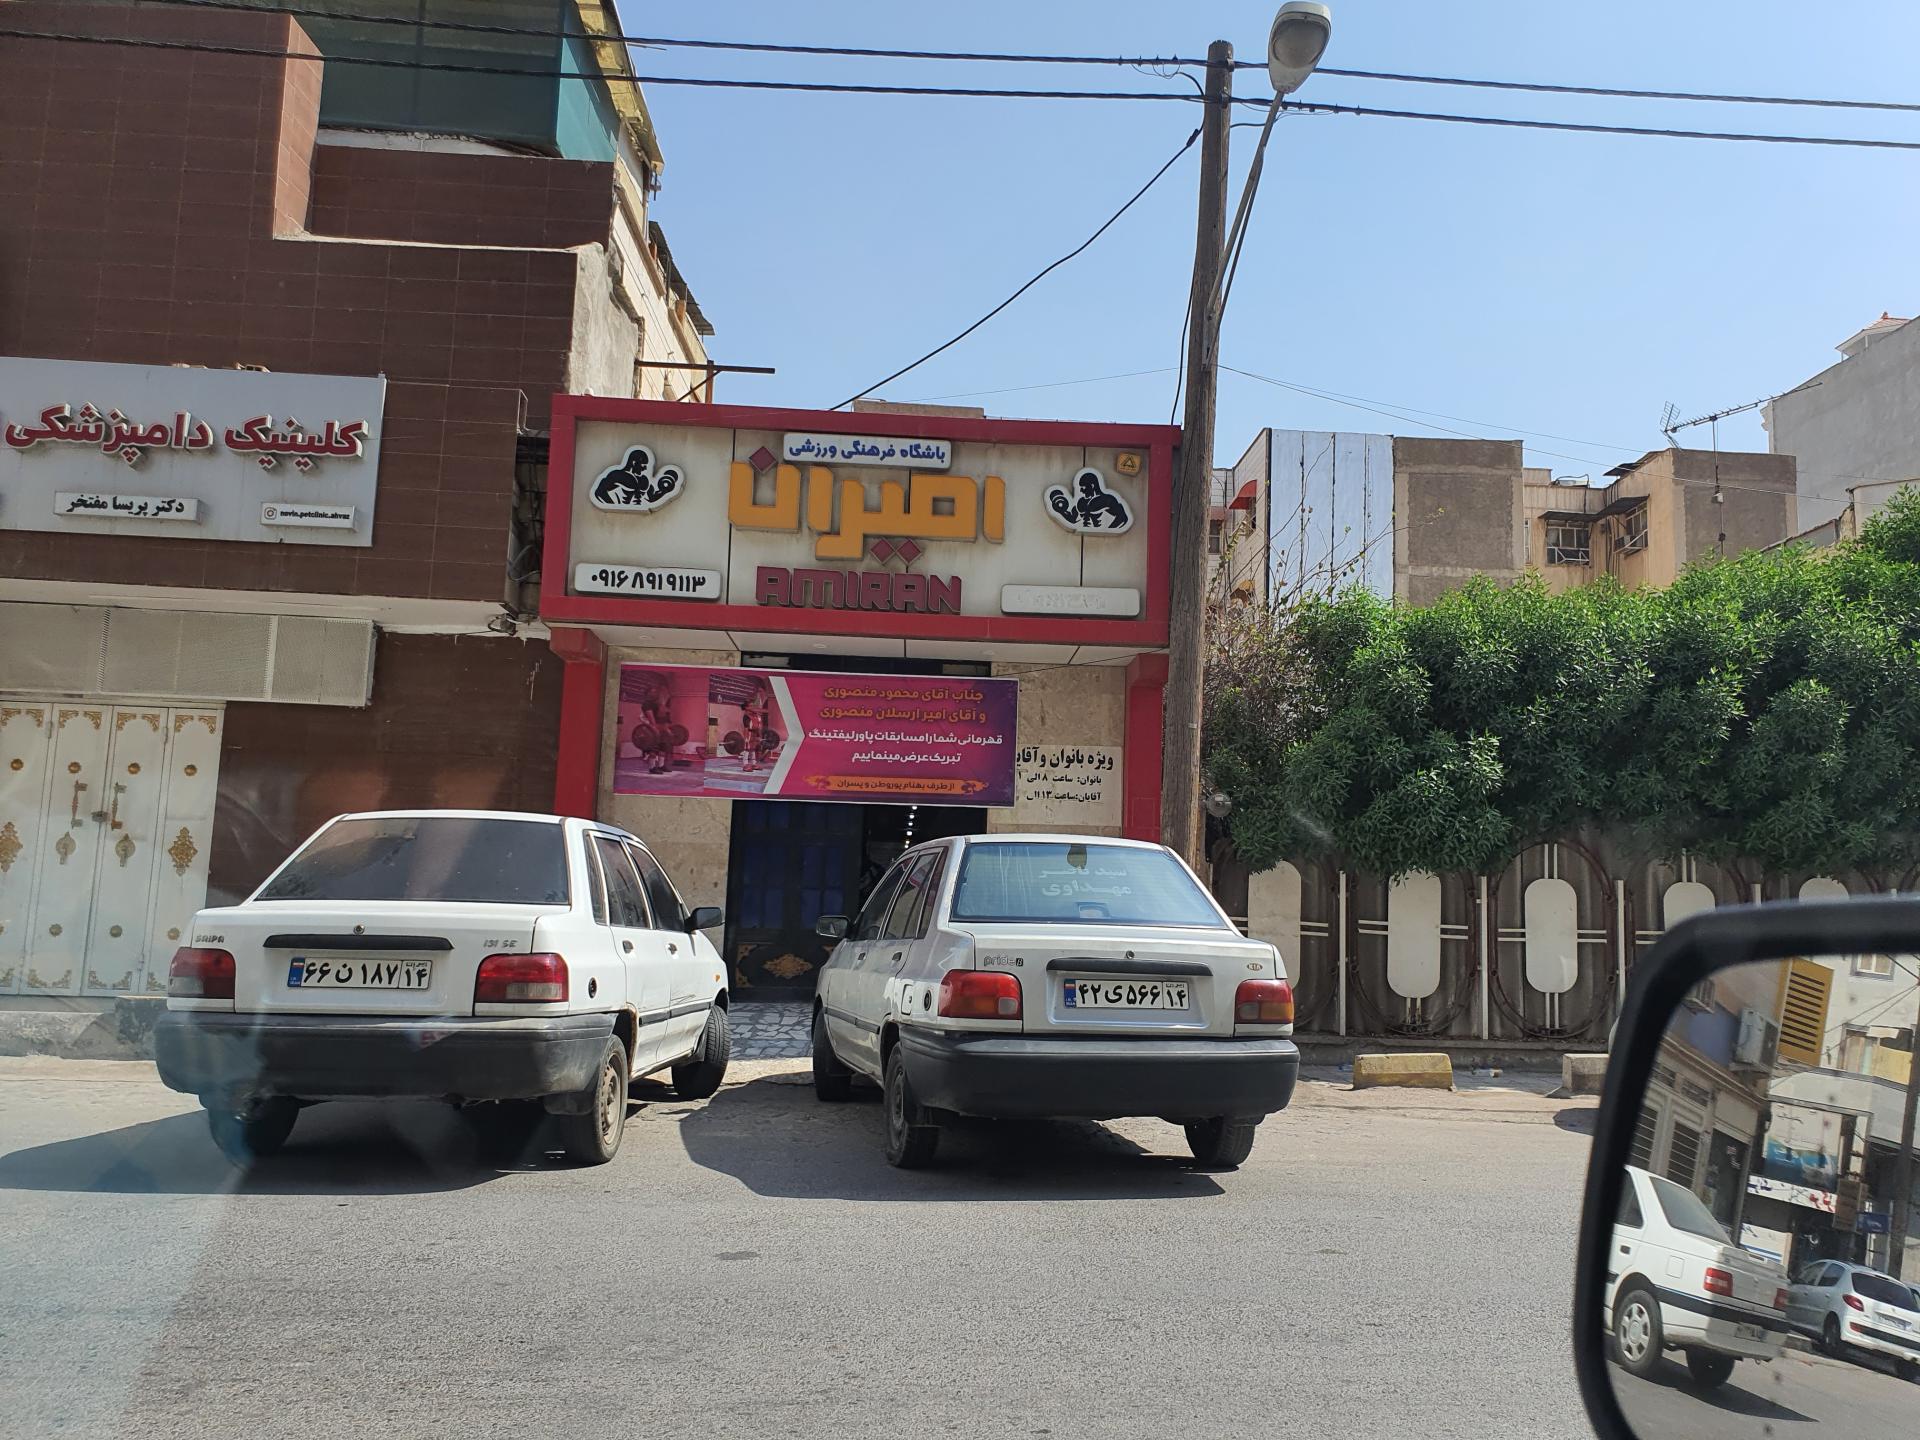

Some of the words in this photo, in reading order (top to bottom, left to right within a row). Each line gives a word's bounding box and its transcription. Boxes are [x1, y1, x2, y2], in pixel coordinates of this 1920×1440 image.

[5, 402, 213, 466] دامپزشکی
[224, 414, 367, 470] کلینیک
[789, 438, 838, 459] ورزشی
[841, 440, 896, 461] فرهنگی
[900, 443, 945, 463] باشگاه
[66, 494, 108, 513] مفتخر
[112, 496, 148, 516] پریسا
[151, 499, 185, 516] دکتر
[728, 446, 1006, 566] امیران
[756, 566, 962, 613] AMIRAN
[824, 685, 877, 698] منصوری
[879, 687, 919, 700] محمود
[921, 686, 949, 702] آقای
[952, 688, 984, 702] جناب
[819, 705, 873, 718] منصوری
[875, 706, 920, 720] ارسلان
[922, 708, 946, 721] امیر
[949, 706, 976, 723] آقای
[979, 712, 986, 724] و
[808, 728, 874, 744] پاورلیفتینگ
[874, 731, 925, 744] مسابقات
[958, 734, 1003, 746] قهرمانی
[900, 751, 930, 763] عرض
[929, 752, 961, 764] تبریک
[1016, 746, 1040, 767] آقای
[1039, 754, 1046, 767] و
[1049, 748, 1085, 769] بانوان
[1087, 750, 1114, 770] ویژه
[1027, 772, 1040, 783] الی
[1042, 773, 1048, 781] ۸
[1052, 774, 1073, 782] ساعت
[1077, 775, 1101, 785] بانوان:
[502, 939, 518, 948] SE
